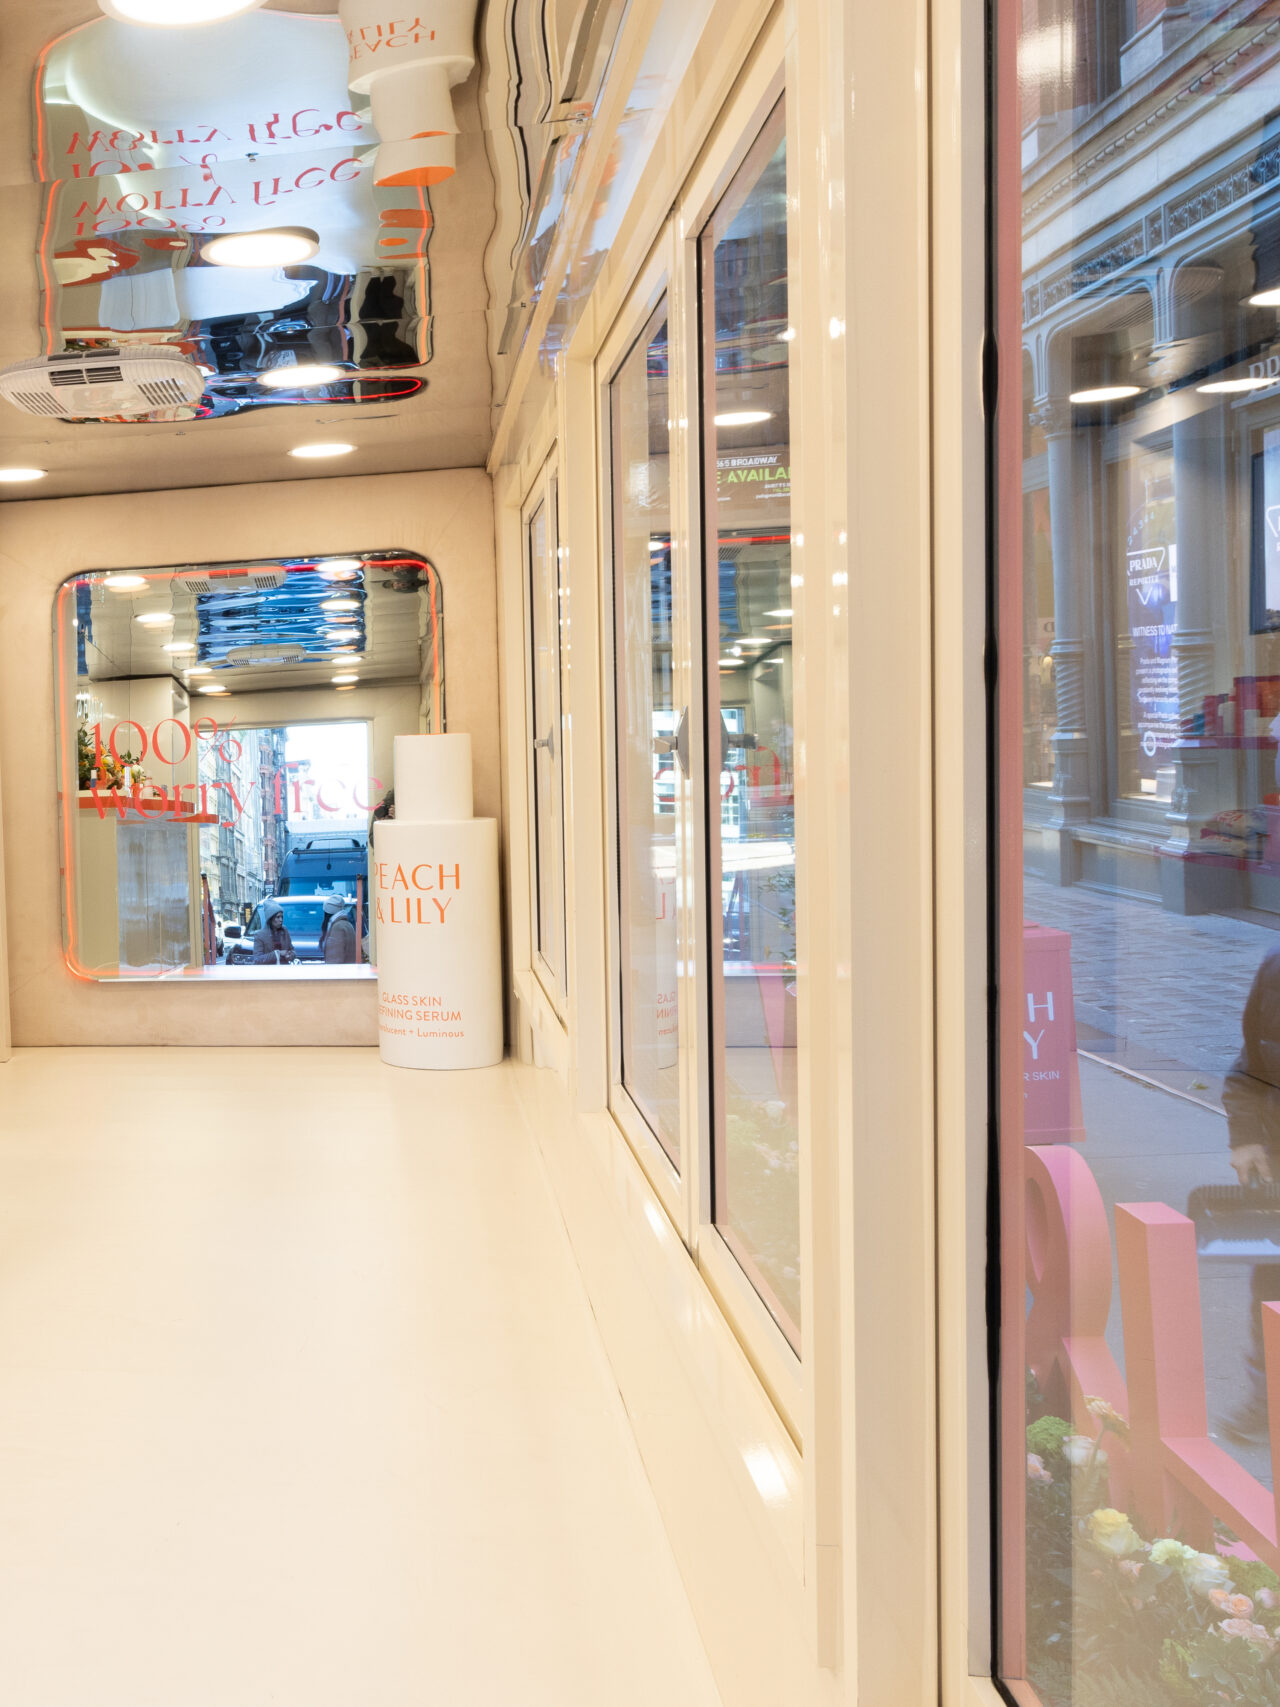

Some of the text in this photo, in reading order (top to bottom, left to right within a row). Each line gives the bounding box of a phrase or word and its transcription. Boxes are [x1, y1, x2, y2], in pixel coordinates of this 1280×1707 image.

[726, 466, 791, 484] AVAILA
[1129, 556, 1158, 572] PRADA
[90, 715, 242, 769] 100%
[89, 762, 385, 829] worry free
[389, 896, 452, 925] LILY
[382, 991, 443, 1008] GLASS SKIN
[415, 1010, 462, 1022] SERUM
[416, 1027, 465, 1038] Luminous
[1032, 1070, 1061, 1081] SKIN
